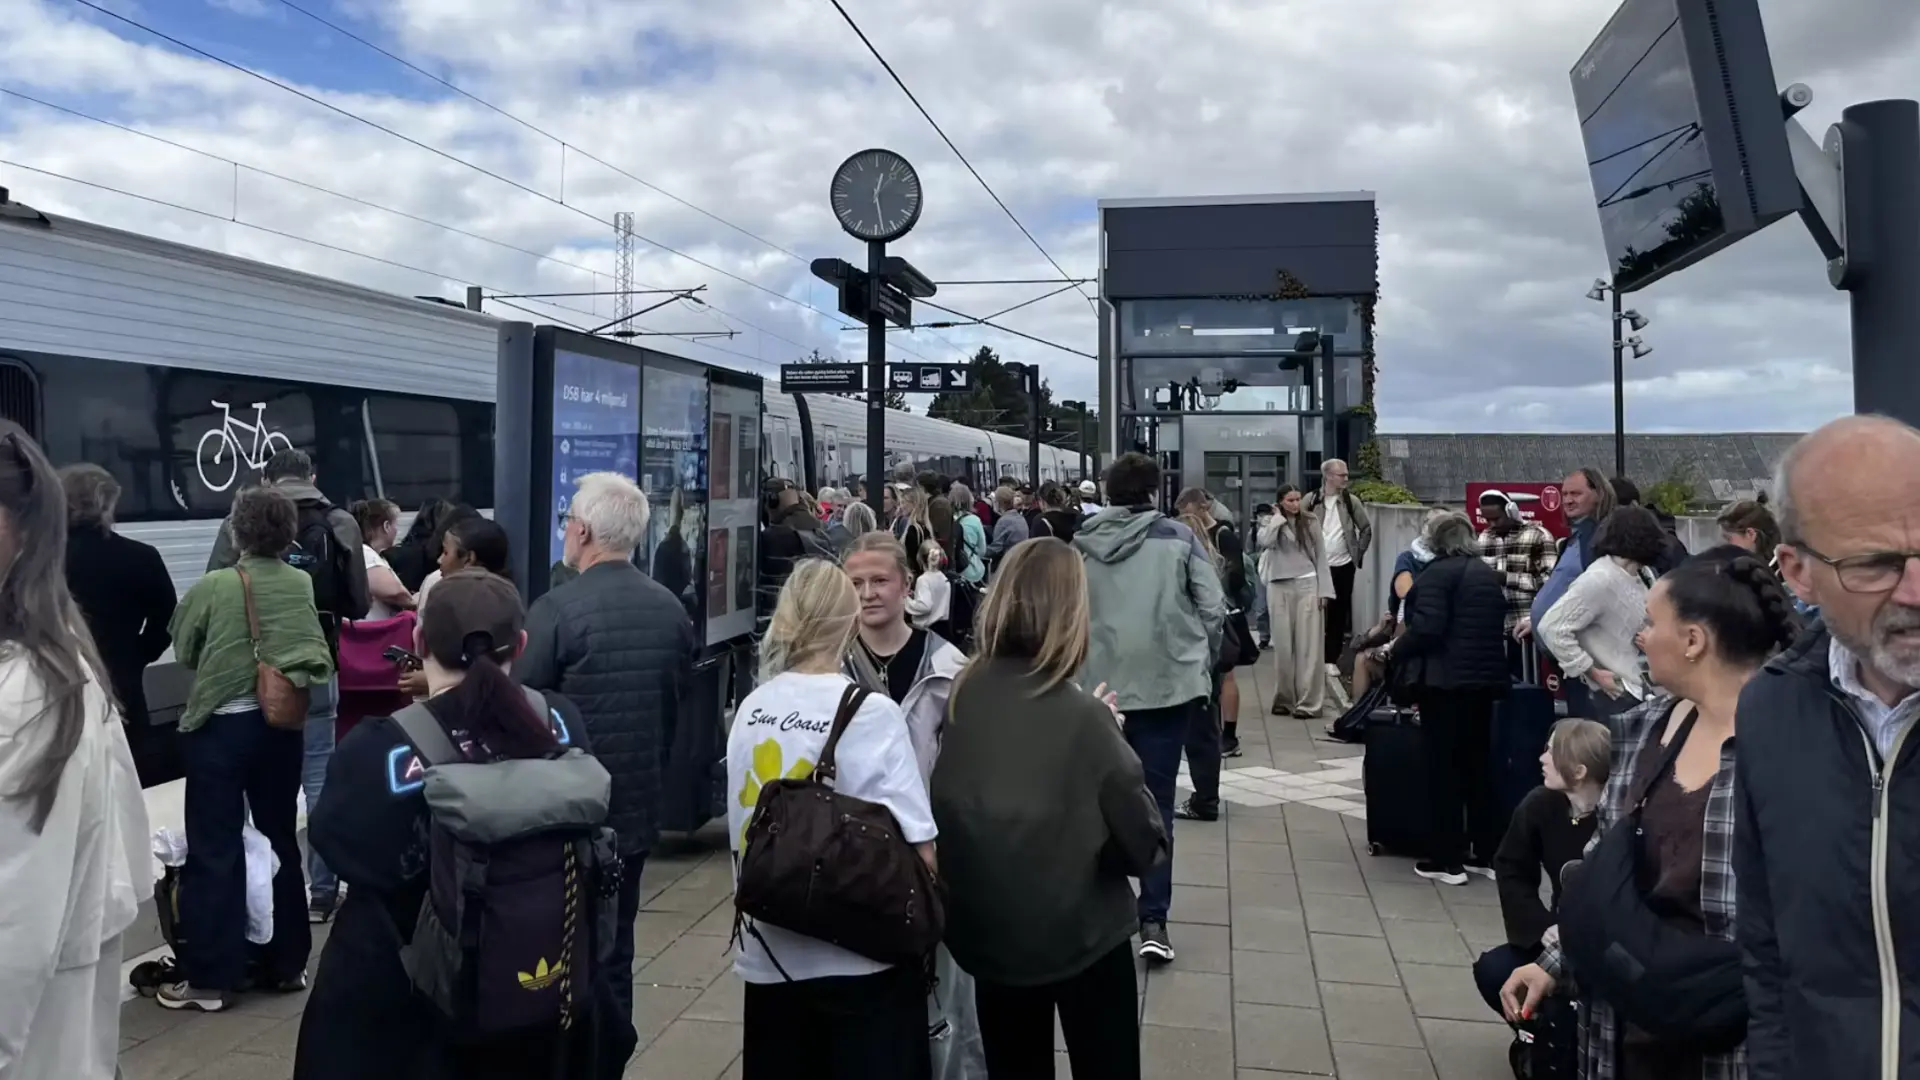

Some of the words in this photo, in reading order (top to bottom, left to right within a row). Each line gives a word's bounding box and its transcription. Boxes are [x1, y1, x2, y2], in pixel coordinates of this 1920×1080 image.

[563, 384, 580, 401] DSB
[747, 708, 778, 726] Sun
[780, 711, 830, 733] Coast
